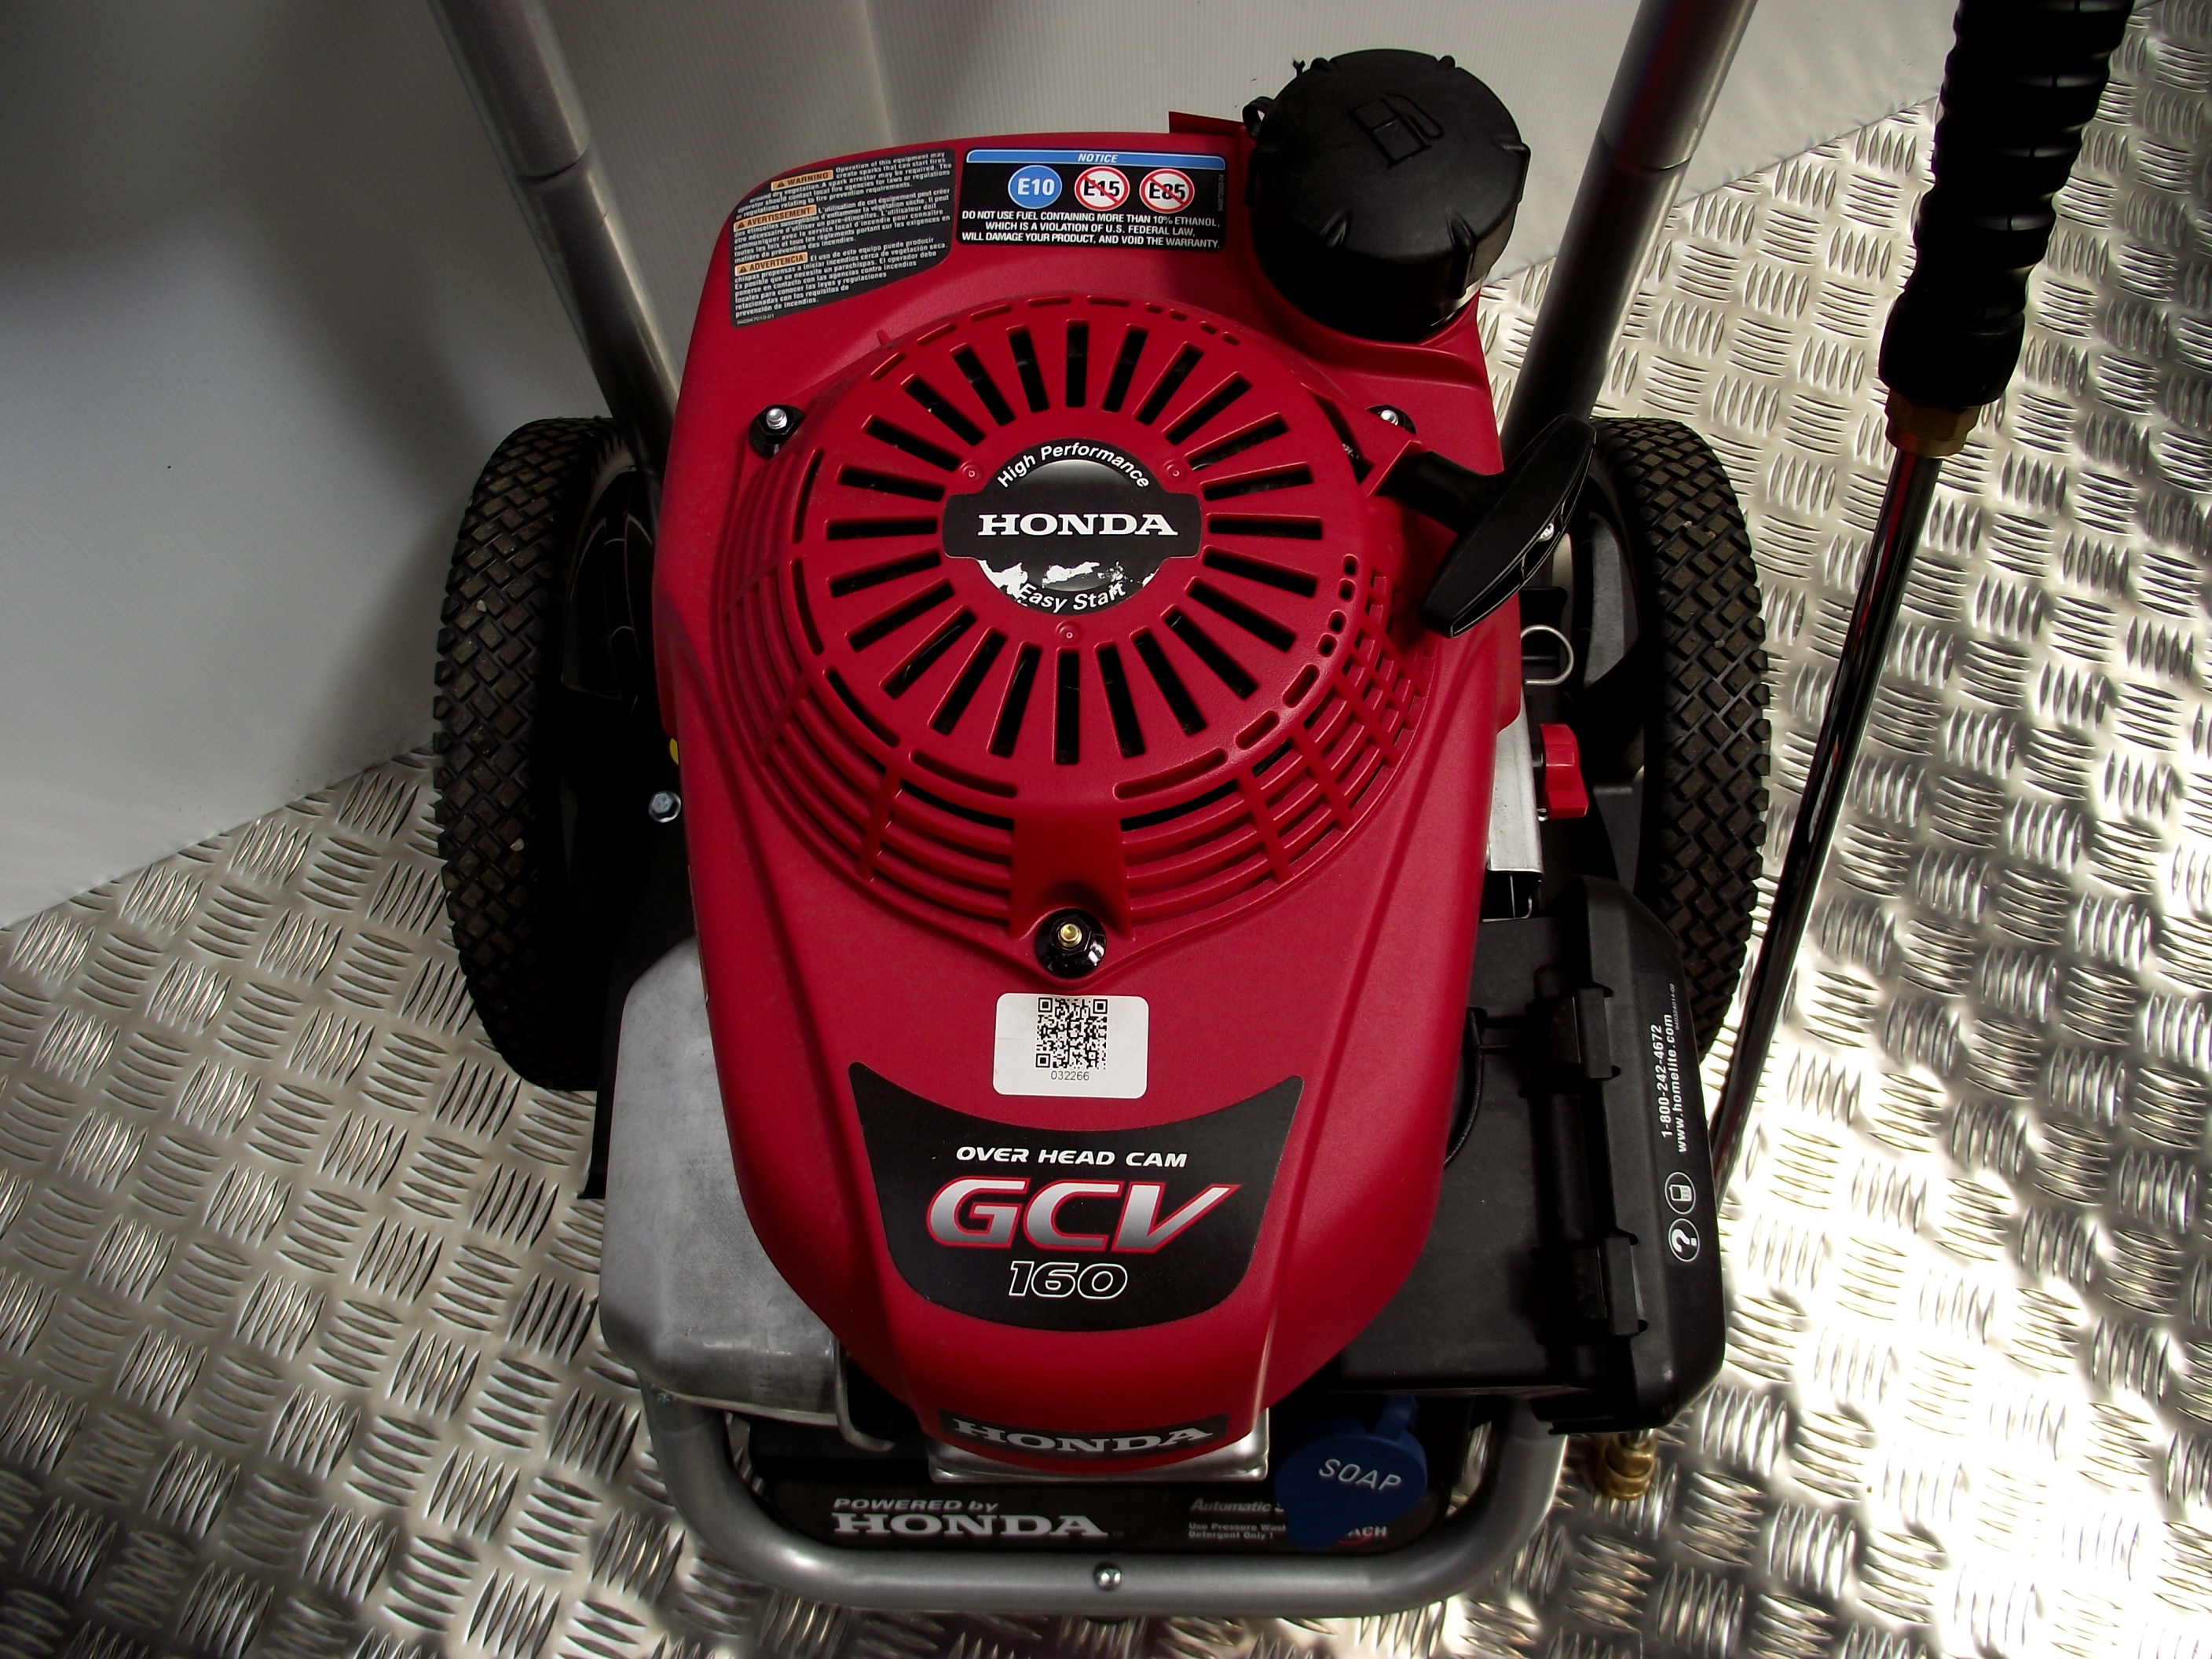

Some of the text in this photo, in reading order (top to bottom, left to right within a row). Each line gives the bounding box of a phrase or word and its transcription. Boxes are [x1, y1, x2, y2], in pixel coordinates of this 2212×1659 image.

[836, 163, 869, 174] Operation
[893, 153, 928, 163] equipment
[1079, 153, 1118, 163] NOTICE
[787, 172, 828, 185] WARNING
[789, 191, 811, 200] contact
[844, 181, 873, 190] agencies
[913, 170, 950, 179] regulations
[829, 178, 847, 187] spark
[905, 165, 936, 174] required.
[830, 189, 864, 200] prevention
[866, 182, 912, 193] requirements.
[1017, 178, 1185, 200] E10 E15 E85
[746, 208, 810, 225] AVERTISSEMENT
[856, 225, 880, 234] portant
[906, 217, 939, 225] exigences
[962, 211, 1220, 228] DO NOT USE FUEL CONTAINING MORE THAN 10% ETHANOL,
[985, 222, 1017, 230] WHICH
[1040, 222, 1088, 232] VIOLATION
[1106, 225, 1125, 233] U.S.
[1128, 225, 1170, 235] FEDERAL
[1173, 227, 1195, 236] LAW,
[883, 242, 903, 251] puede
[906, 237, 934, 247] producir
[986, 233, 1023, 241] DAMAGE
[1025, 233, 1049, 242] YOUR
[1052, 233, 1096, 244] PRODUCT,
[1099, 235, 1119, 244] AND
[1121, 236, 1144, 244] VOID
[1147, 236, 1163, 245] THE
[1166, 238, 1220, 248] WARRANTY.
[749, 255, 804, 270] ADVERTENCIA
[826, 256, 859, 265] incendios
[891, 245, 928, 255] vegetación
[794, 269, 822, 277] necesite
[888, 254, 918, 263] operador
[735, 287, 761, 298] ponerse
[774, 280, 801, 288] contacto
[829, 270, 859, 279] agencias
[843, 273, 886, 283] regulaciones
[735, 298, 778, 309] relacionadas
[806, 287, 839, 297] requisitos
[735, 306, 772, 318] prevención
[784, 298, 819, 307] incendios.
[997, 442, 1149, 488] High Performance
[977, 513, 1178, 536] HONDA
[1017, 584, 1126, 613] Easy Start
[1050, 1071, 1090, 1080] 032266
[1650, 1024, 1672, 1138] 1-800-242-4672
[1664, 1014, 1686, 1153] www.homelite.com
[956, 1147, 1187, 1167] OVER HEAD CAM
[926, 1176, 1243, 1254] GCV
[1009, 1260, 1128, 1300] 160
[953, 1418, 1213, 1452] HONDA
[1319, 1459, 1401, 1490] SOAP
[833, 1498, 999, 1512] POWERED by
[1190, 1498, 1271, 1512] Automatic
[831, 1512, 1108, 1536] HONDA
[1211, 1522, 1258, 1531] Pressure
[1348, 1526, 1387, 1536] ACH
[1188, 1531, 1240, 1540] Detergent
[1243, 1531, 1266, 1540] Only
